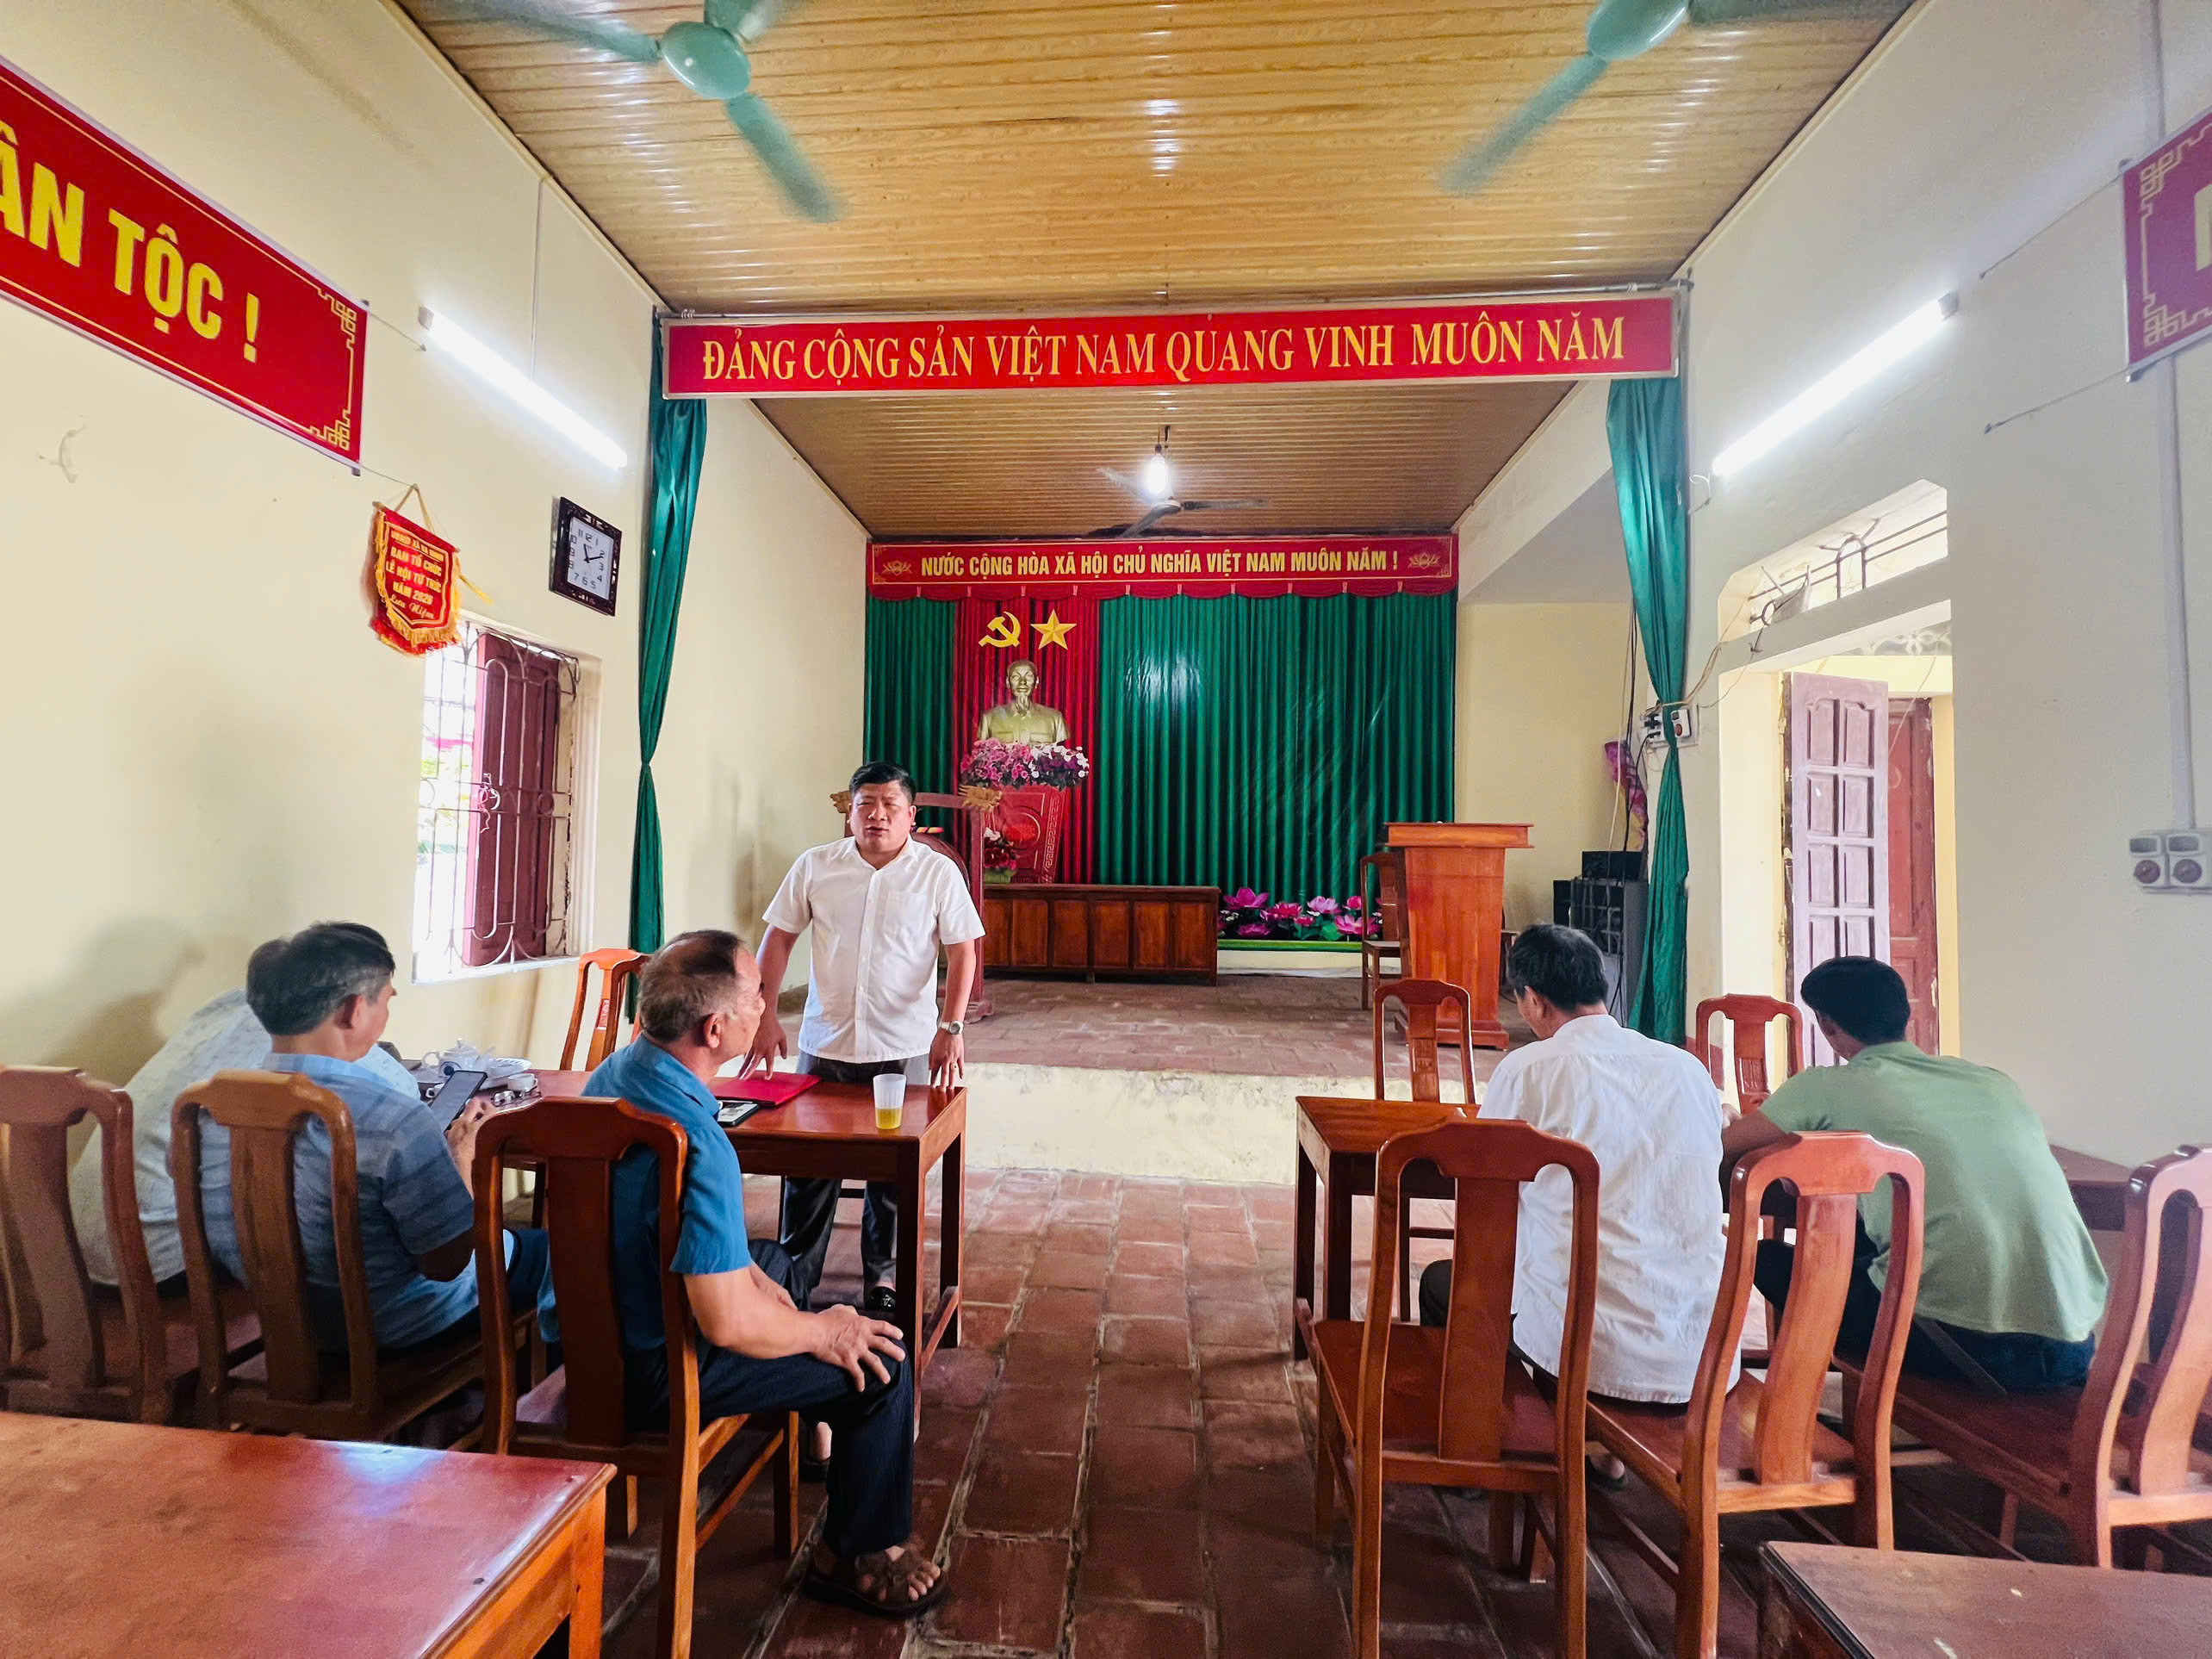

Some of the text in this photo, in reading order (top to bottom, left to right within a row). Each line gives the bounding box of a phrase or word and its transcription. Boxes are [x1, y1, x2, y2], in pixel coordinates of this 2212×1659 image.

[109, 208, 223, 339] TỘC
[702, 311, 1625, 386] ĐẢNG CỘNG SẢN VIỆT NAM QUANG VINH MUÔN NĂM
[921, 551, 965, 577] NƯỚC
[969, 553, 1013, 581] CỘNG
[1017, 550, 1050, 575] HÒA
[1054, 551, 1076, 575] XÃ
[1081, 550, 1108, 579] HỘI
[1113, 545, 1145, 574] CHỦ
[1151, 550, 1202, 574] NGHĨA
[1206, 549, 1242, 576] VIỆT
[1246, 551, 1285, 572] NAM
[1290, 547, 1341, 572] MUÔN
[1346, 546, 1387, 571] NĂM
